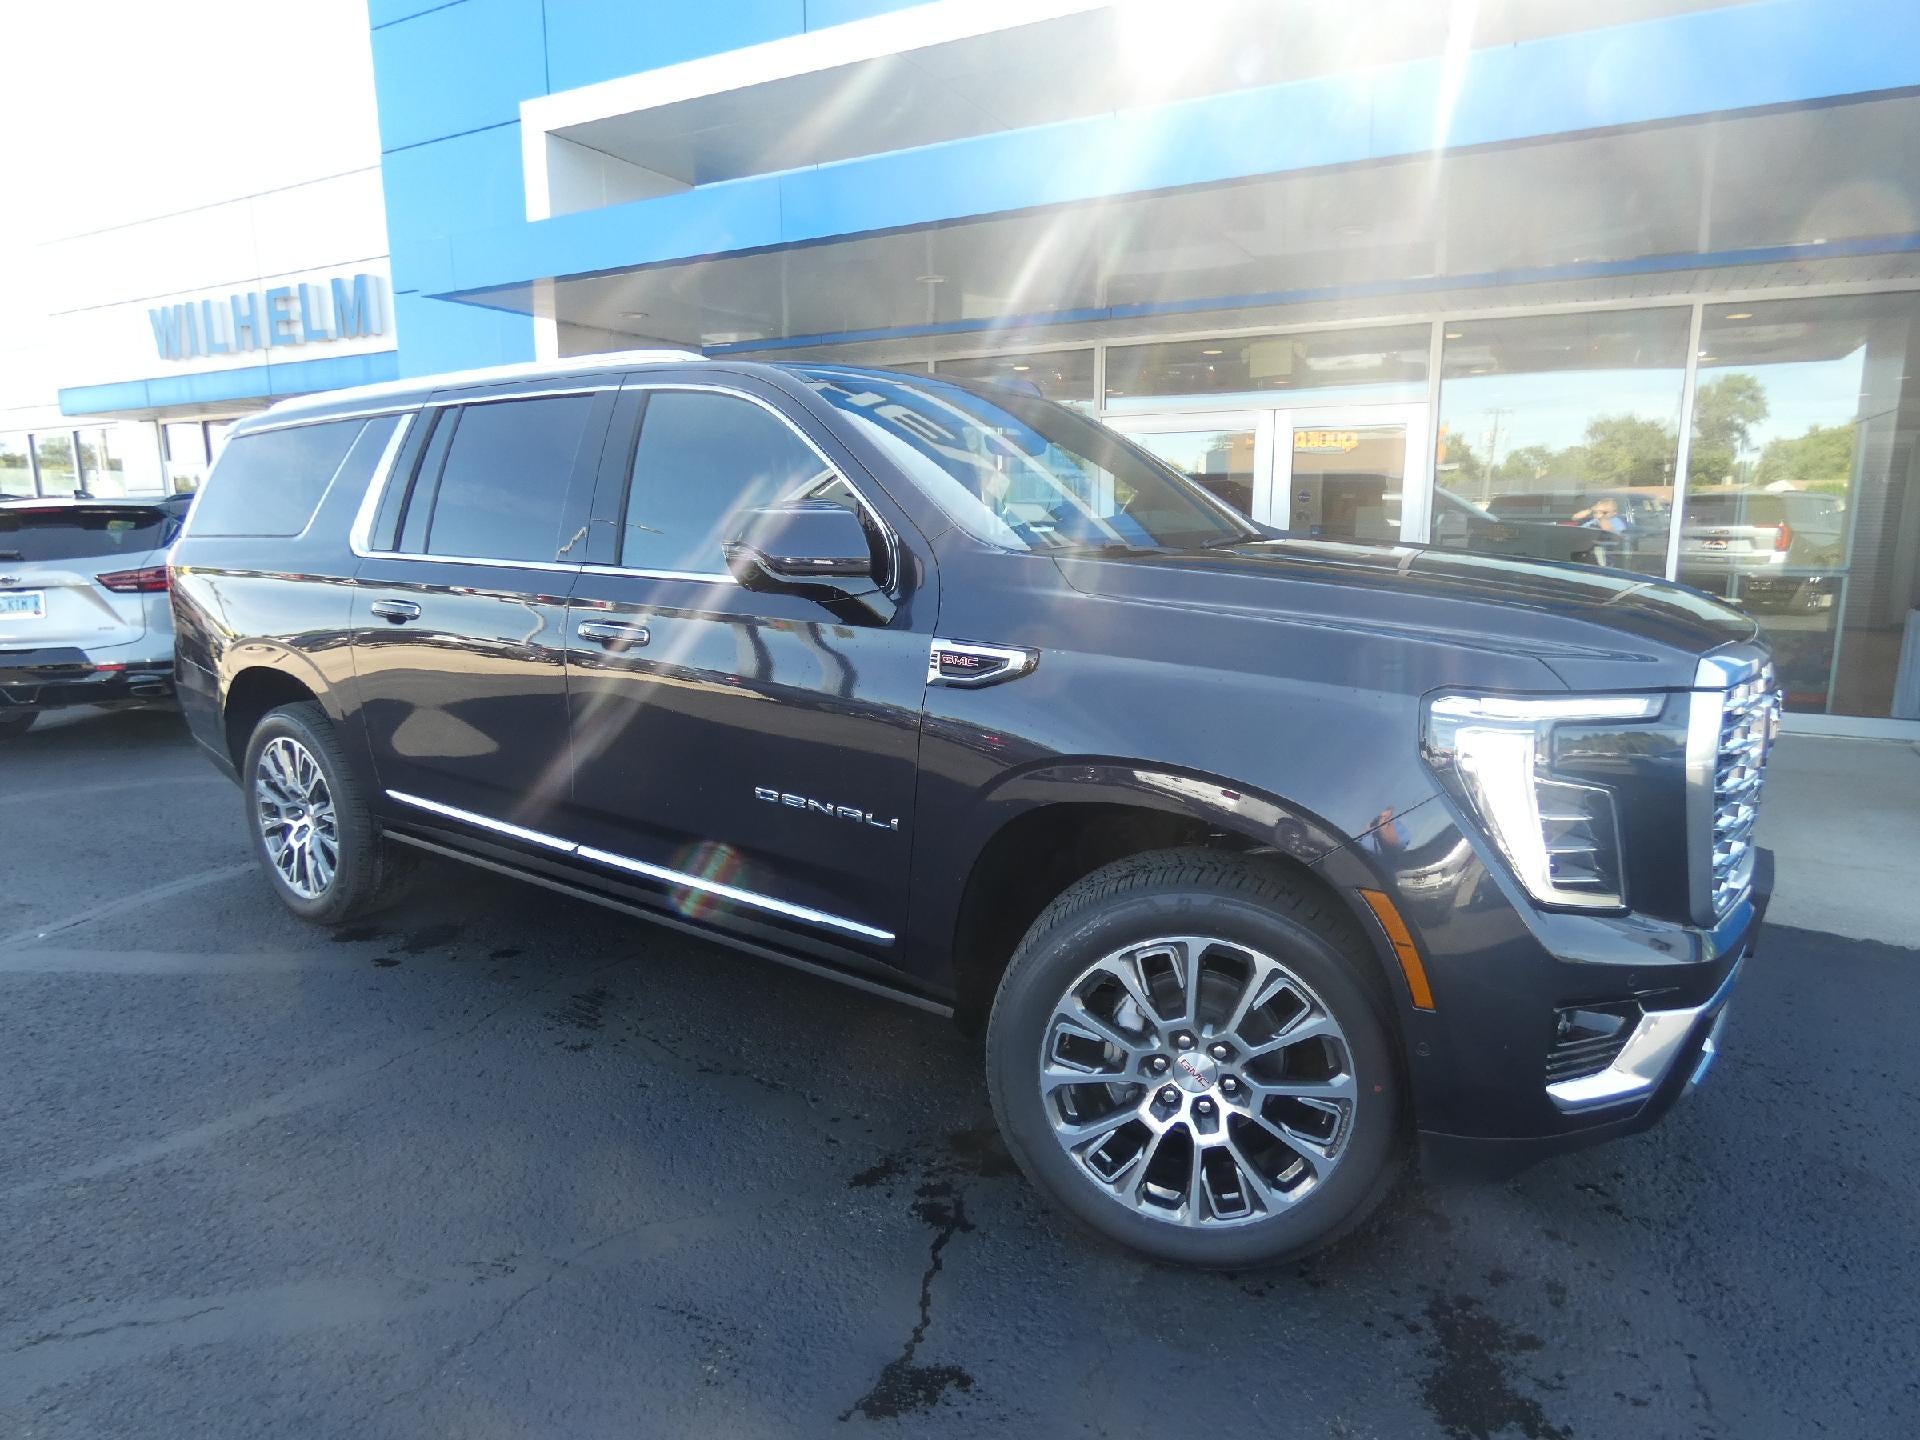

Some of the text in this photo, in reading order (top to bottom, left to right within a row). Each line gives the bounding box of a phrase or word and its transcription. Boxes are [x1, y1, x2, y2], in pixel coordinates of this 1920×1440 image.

[148, 274, 382, 361] WILHELM
[942, 654, 979, 667] GMC
[755, 787, 899, 831] DENALI
[1180, 1059, 1210, 1088] GMC
